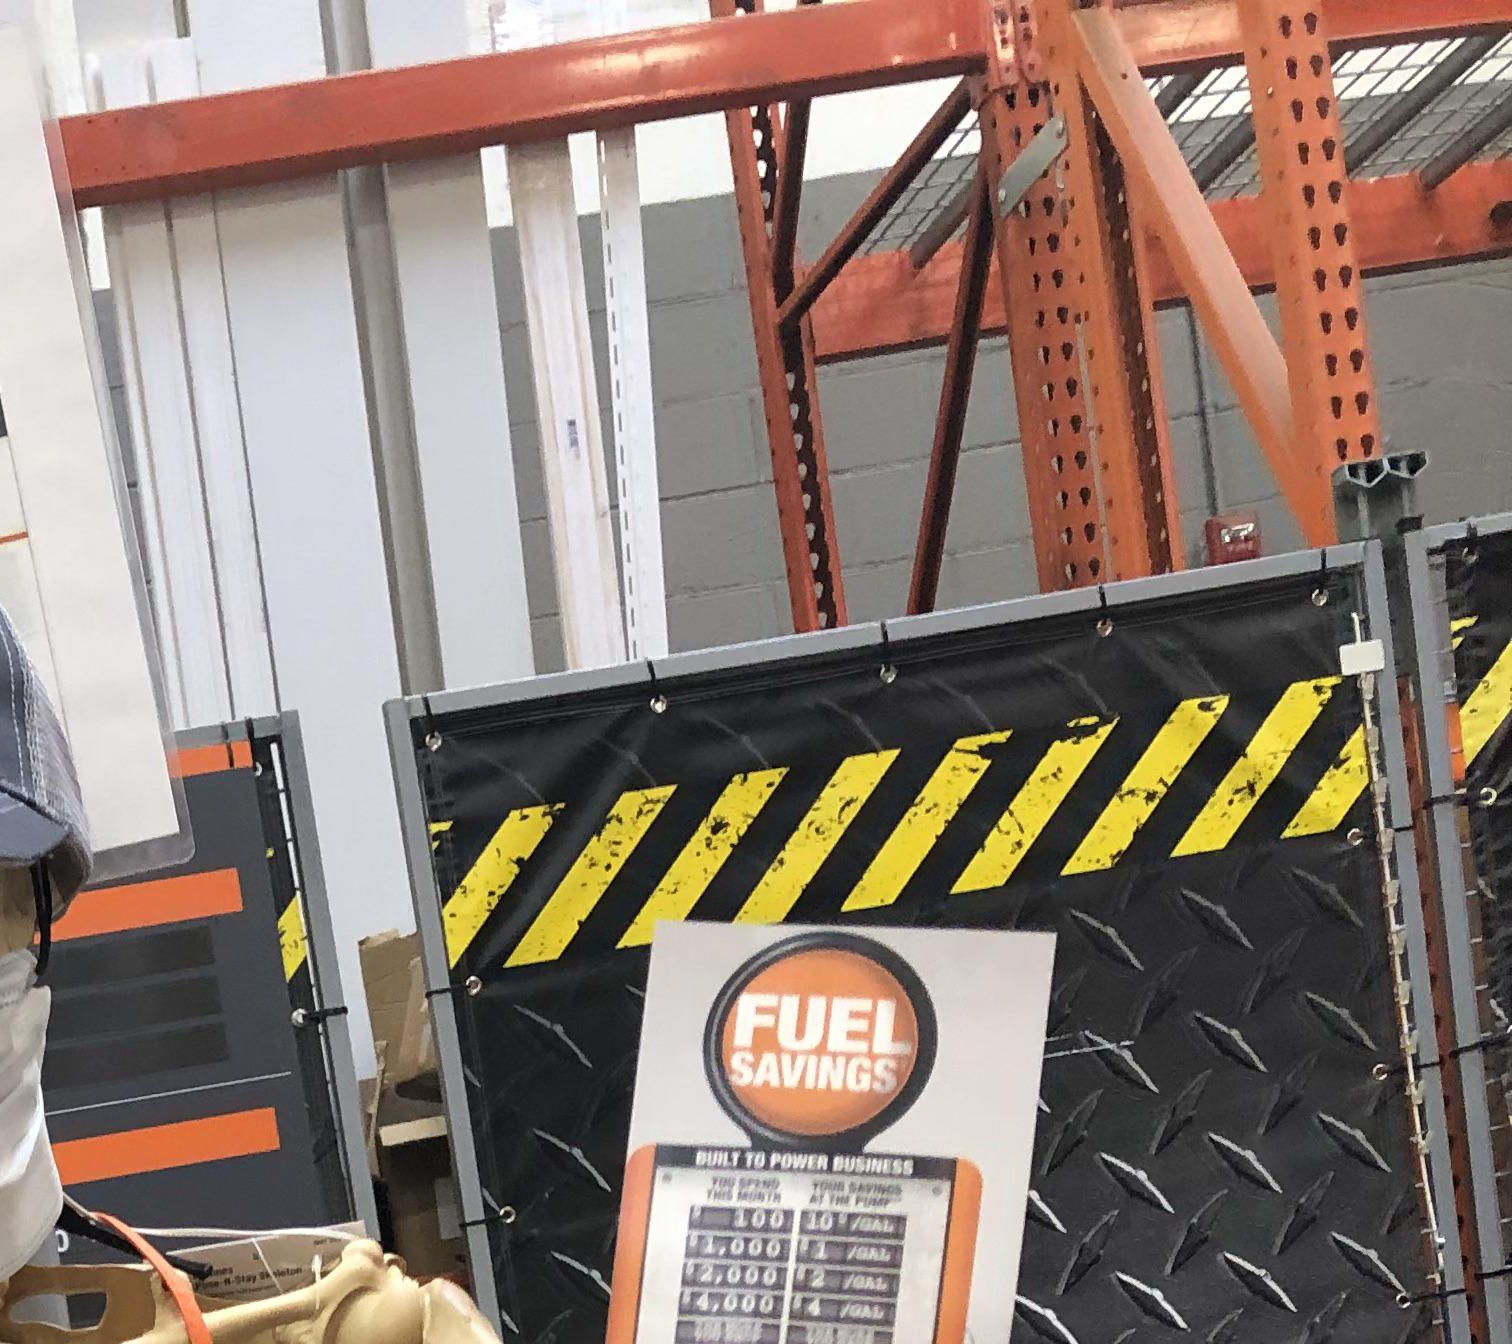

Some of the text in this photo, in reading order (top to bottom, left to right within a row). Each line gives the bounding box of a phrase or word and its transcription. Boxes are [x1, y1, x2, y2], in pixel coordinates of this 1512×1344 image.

[732, 993, 913, 1056] FUEL
[728, 1050, 898, 1094] SAVINGS
[695, 1150, 915, 1176] BUILT TO POWER BUSINESS
